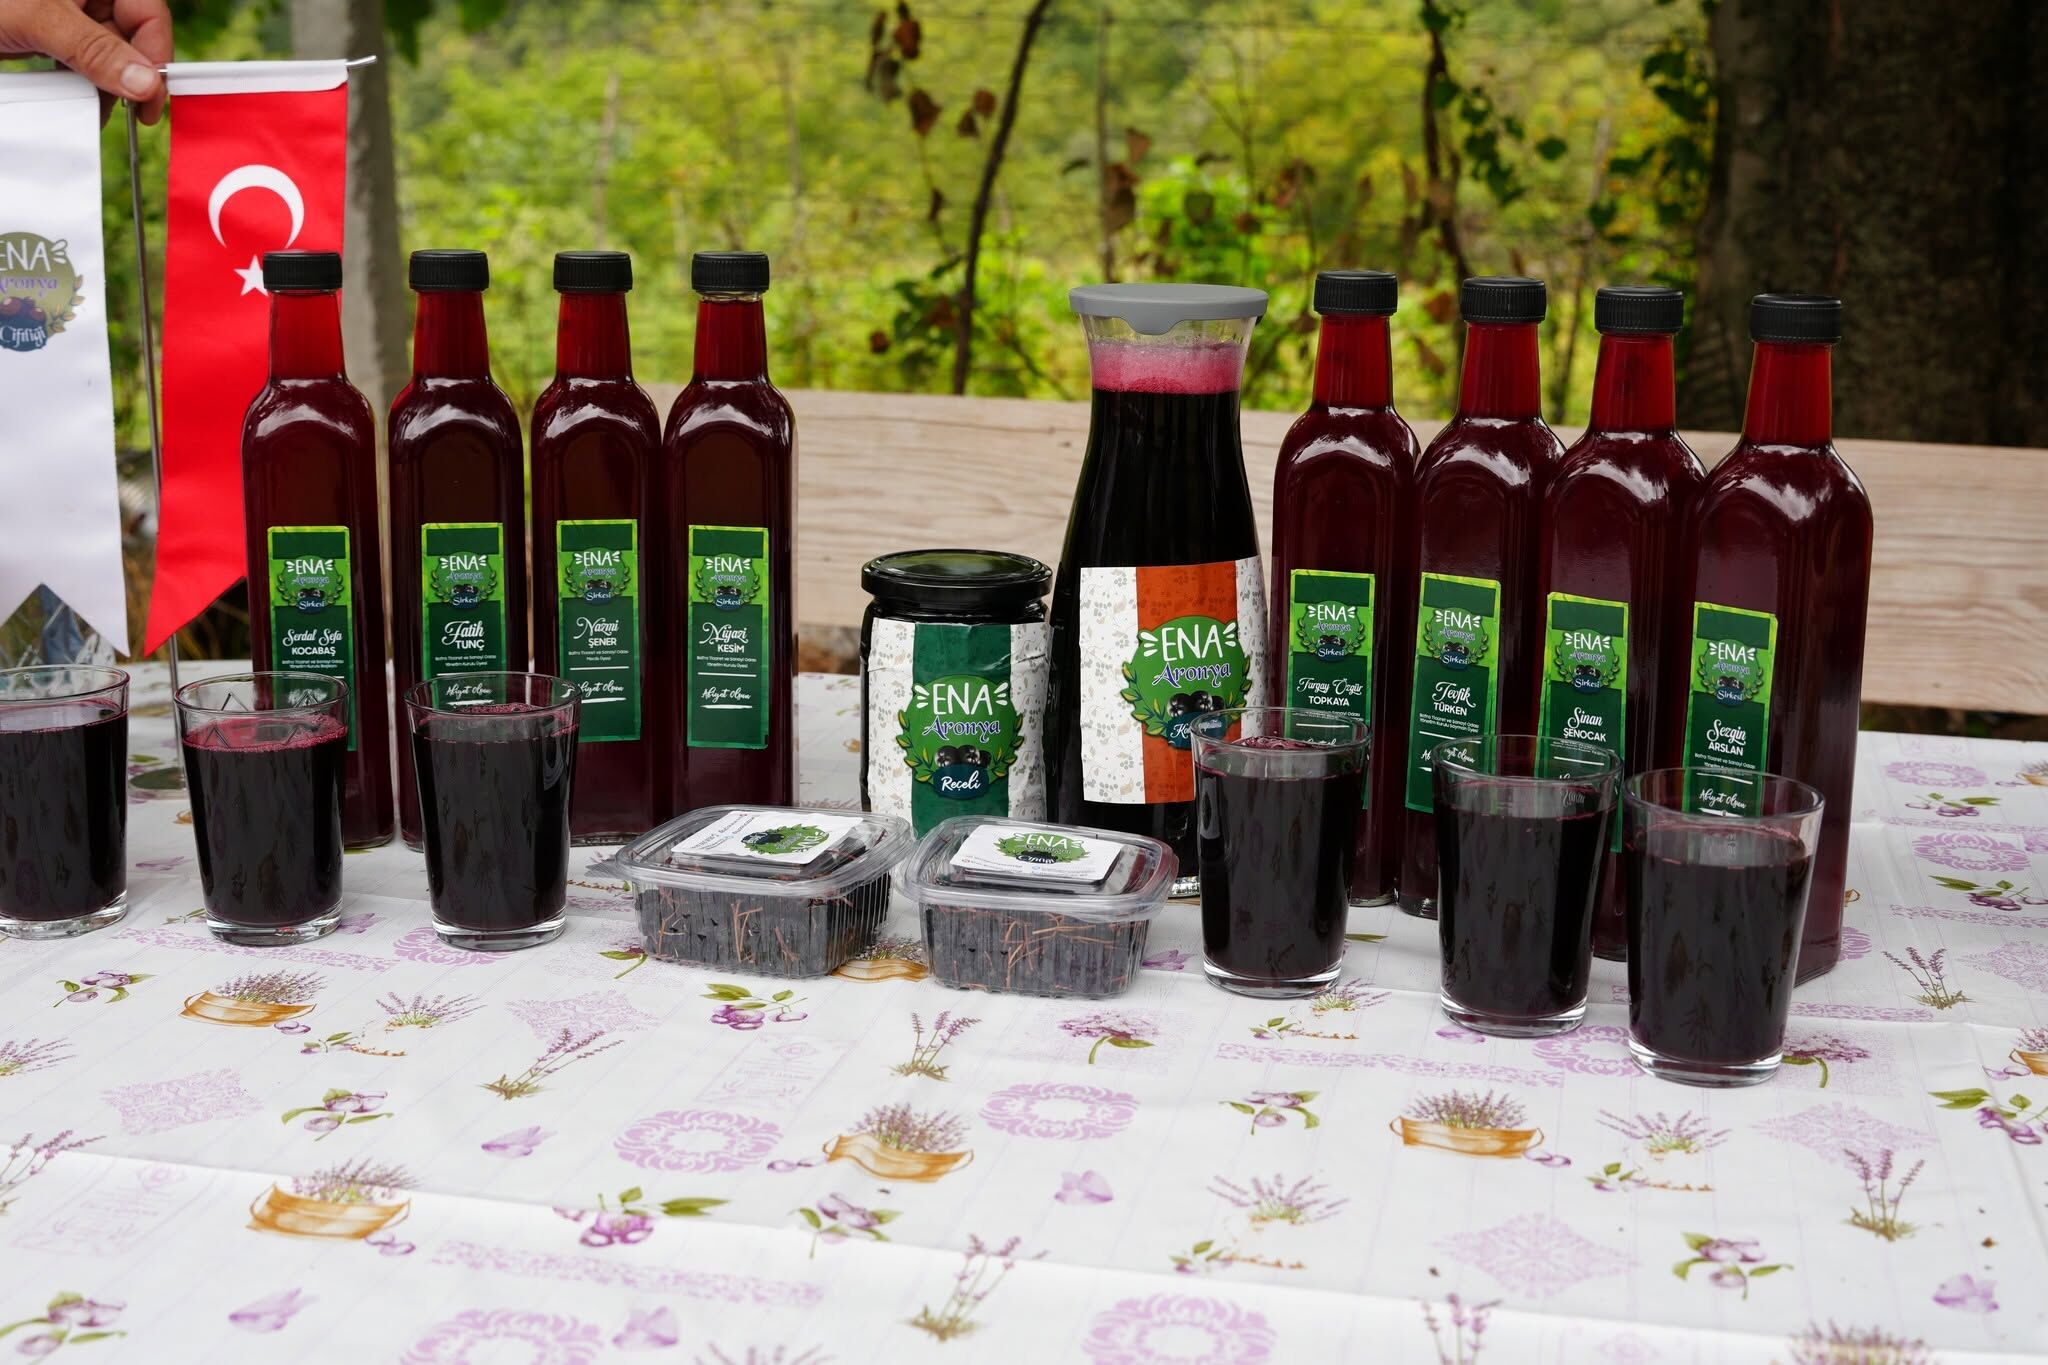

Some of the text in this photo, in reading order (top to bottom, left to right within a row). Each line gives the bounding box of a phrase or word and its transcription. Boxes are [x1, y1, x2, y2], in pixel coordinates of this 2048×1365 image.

[296, 559, 325, 575] ENA
[450, 555, 479, 571] ENA
[583, 551, 613, 567] ENA
[714, 557, 743, 574] ENA
[453, 597, 478, 606] Sirkesi
[586, 592, 612, 601] Sirkesi
[715, 598, 742, 607] Sirkesi
[299, 600, 325, 610] Sirkesi
[1317, 605, 1347, 622] ENA
[1444, 610, 1474, 632] ENA
[441, 620, 484, 645] Fatih
[573, 617, 619, 639] Nazmi
[699, 622, 749, 644] Niyazi
[283, 628, 342, 646] Serdal Sefa
[588, 638, 617, 648] ŞENER
[1162, 624, 1224, 662] ENA
[1574, 632, 1604, 652] ENA
[292, 646, 336, 657] KOCABAŞ
[455, 640, 485, 651] TUNÇ
[717, 642, 745, 653] KESİM
[1318, 648, 1345, 658] Sirkesi
[1718, 642, 1748, 665] ENA
[1443, 654, 1469, 665] Sirkesi
[1152, 661, 1232, 689] Aronya
[1332, 678, 1363, 695] Özgür
[1574, 678, 1601, 689] Sirkesi
[933, 682, 993, 716] ENA
[1308, 695, 1350, 706] TOPKAYA
[1432, 681, 1477, 708] Tevfik
[1717, 690, 1743, 701] Sirkesi
[1433, 701, 1468, 716] TÜRKEN
[1567, 706, 1603, 730] Sinan
[922, 715, 1001, 743] Aronya
[1563, 727, 1607, 742] ŞENOCAK
[1707, 719, 1747, 746] Sezgin
[1708, 741, 1744, 757] ARSLAN
[941, 770, 981, 791] Reçeli
[1027, 834, 1067, 849] ENA
